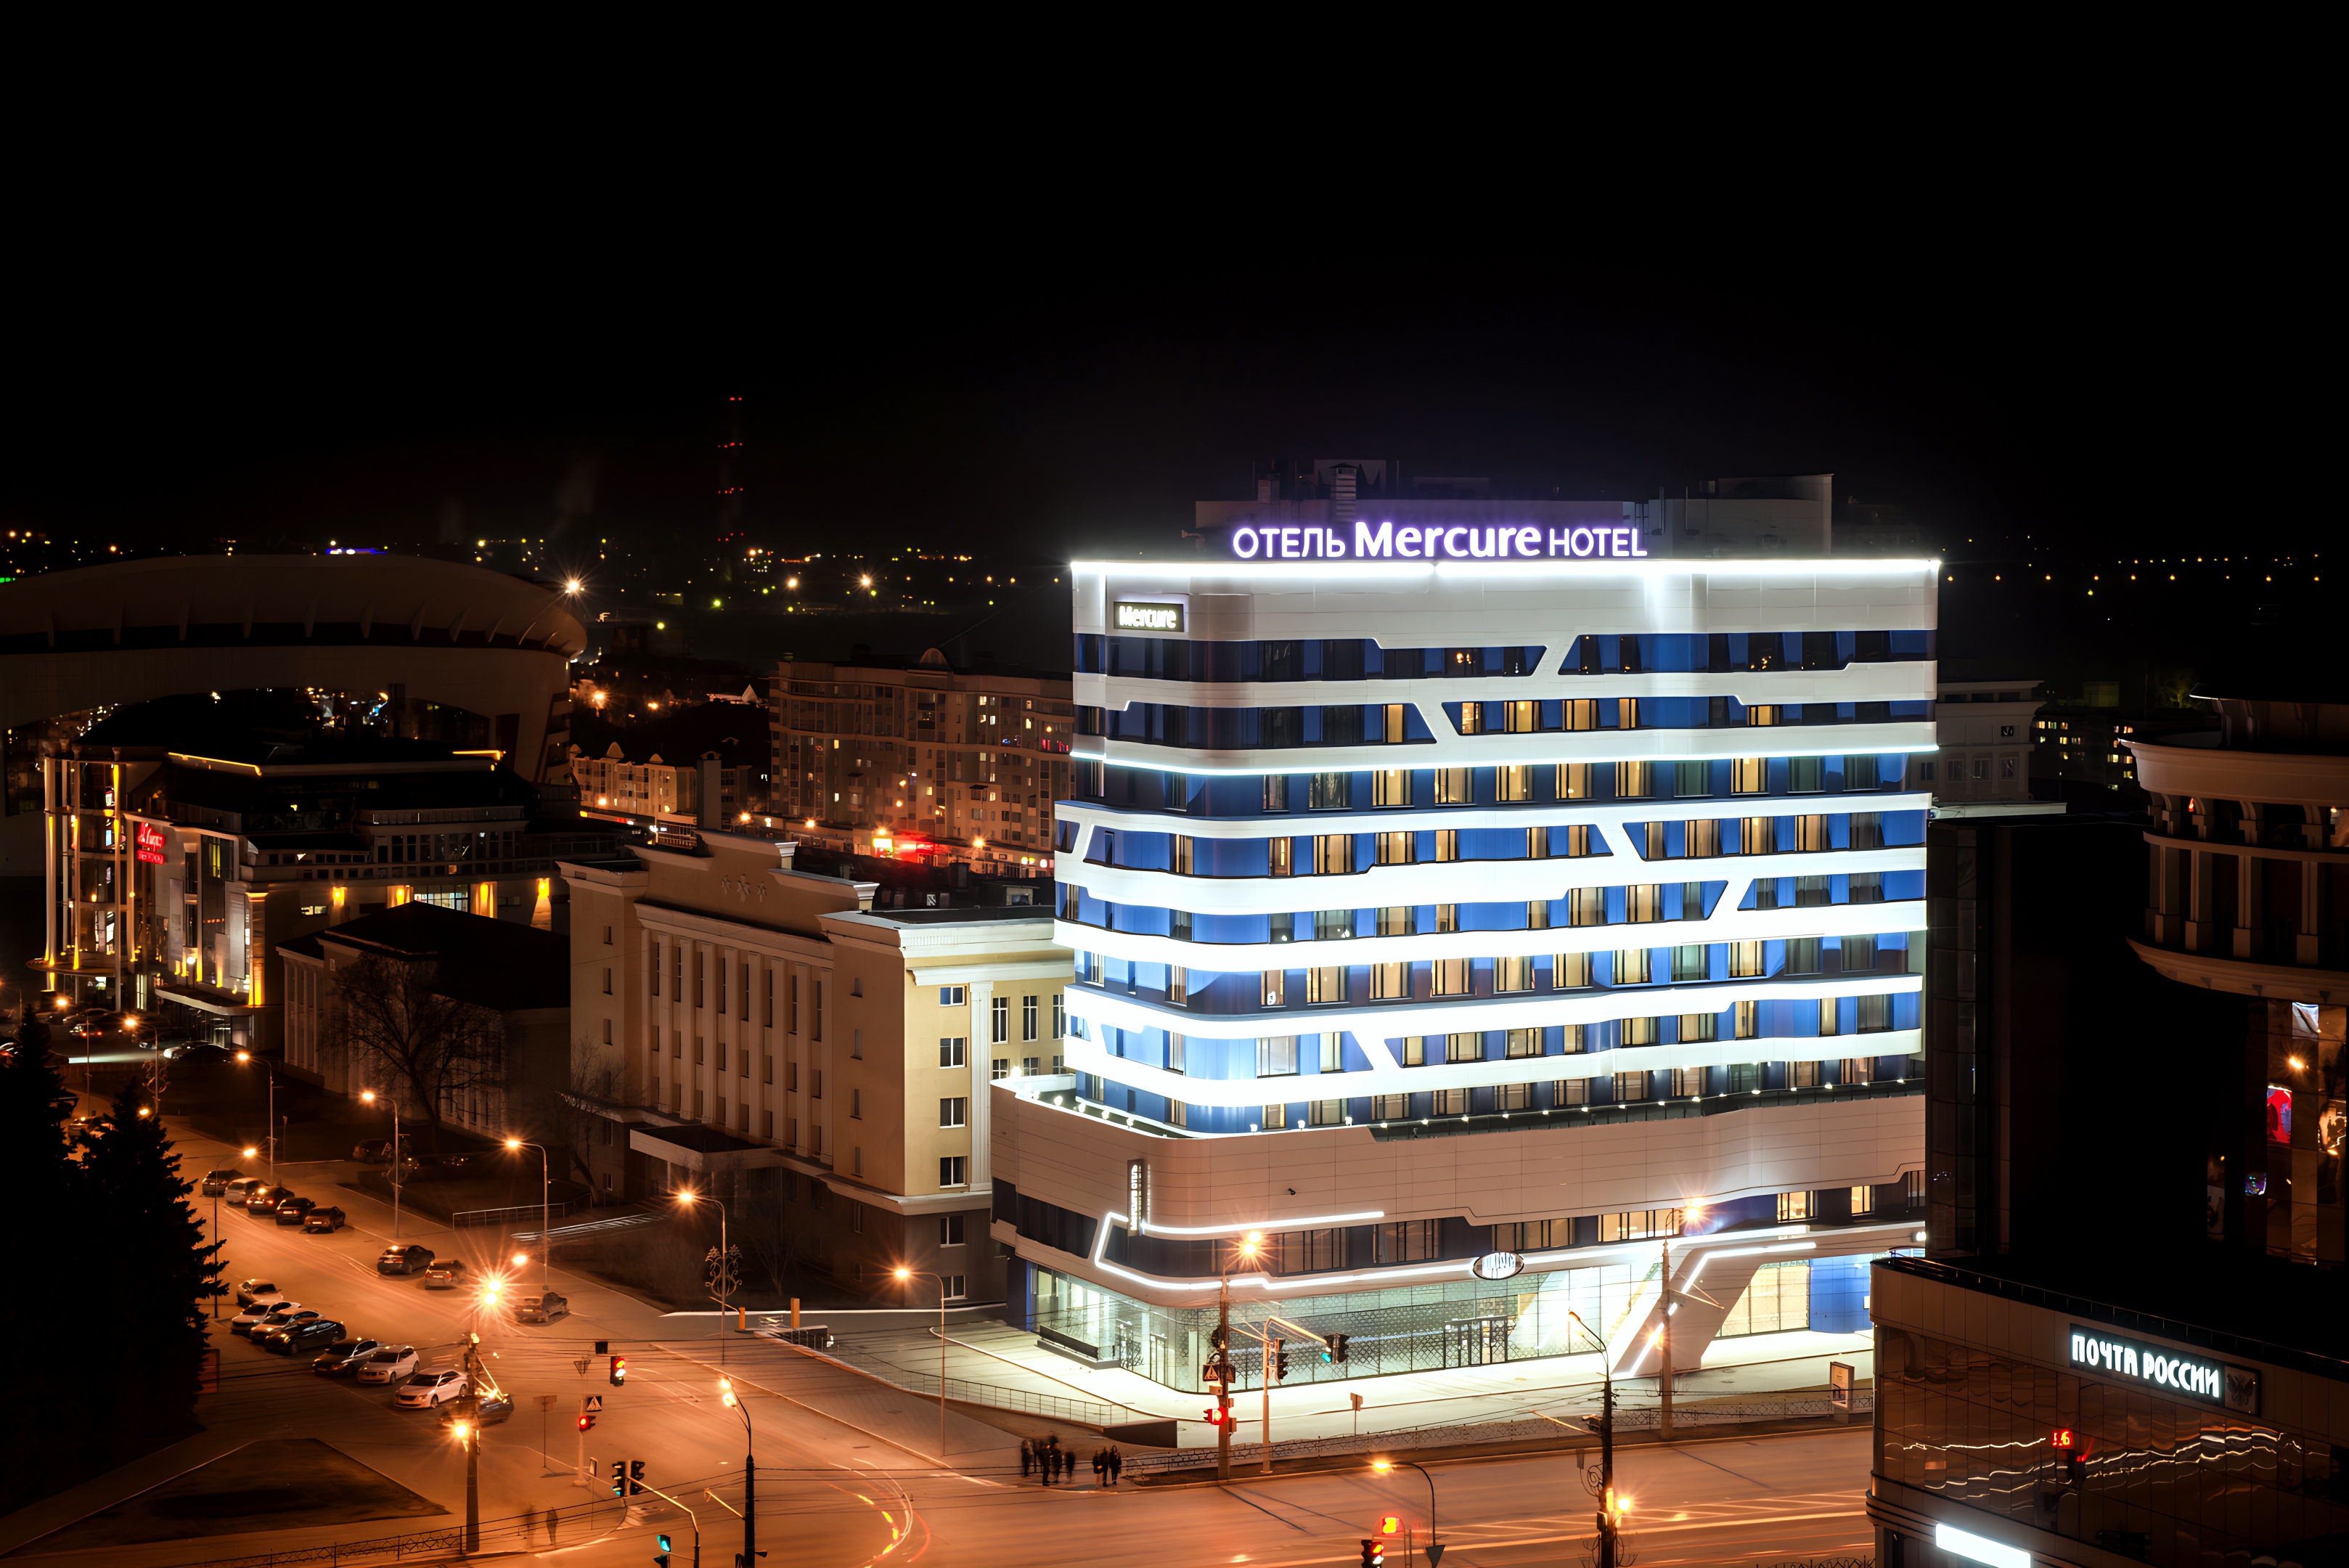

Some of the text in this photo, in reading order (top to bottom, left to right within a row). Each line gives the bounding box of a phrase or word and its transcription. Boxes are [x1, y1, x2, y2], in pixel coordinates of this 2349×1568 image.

[1233, 521, 1648, 558] ОТЕЛЬ Mercure HOTEL
[1119, 605, 1177, 629] Mercure
[2072, 1334, 2219, 1398] ПОЧТА РОССИИ
